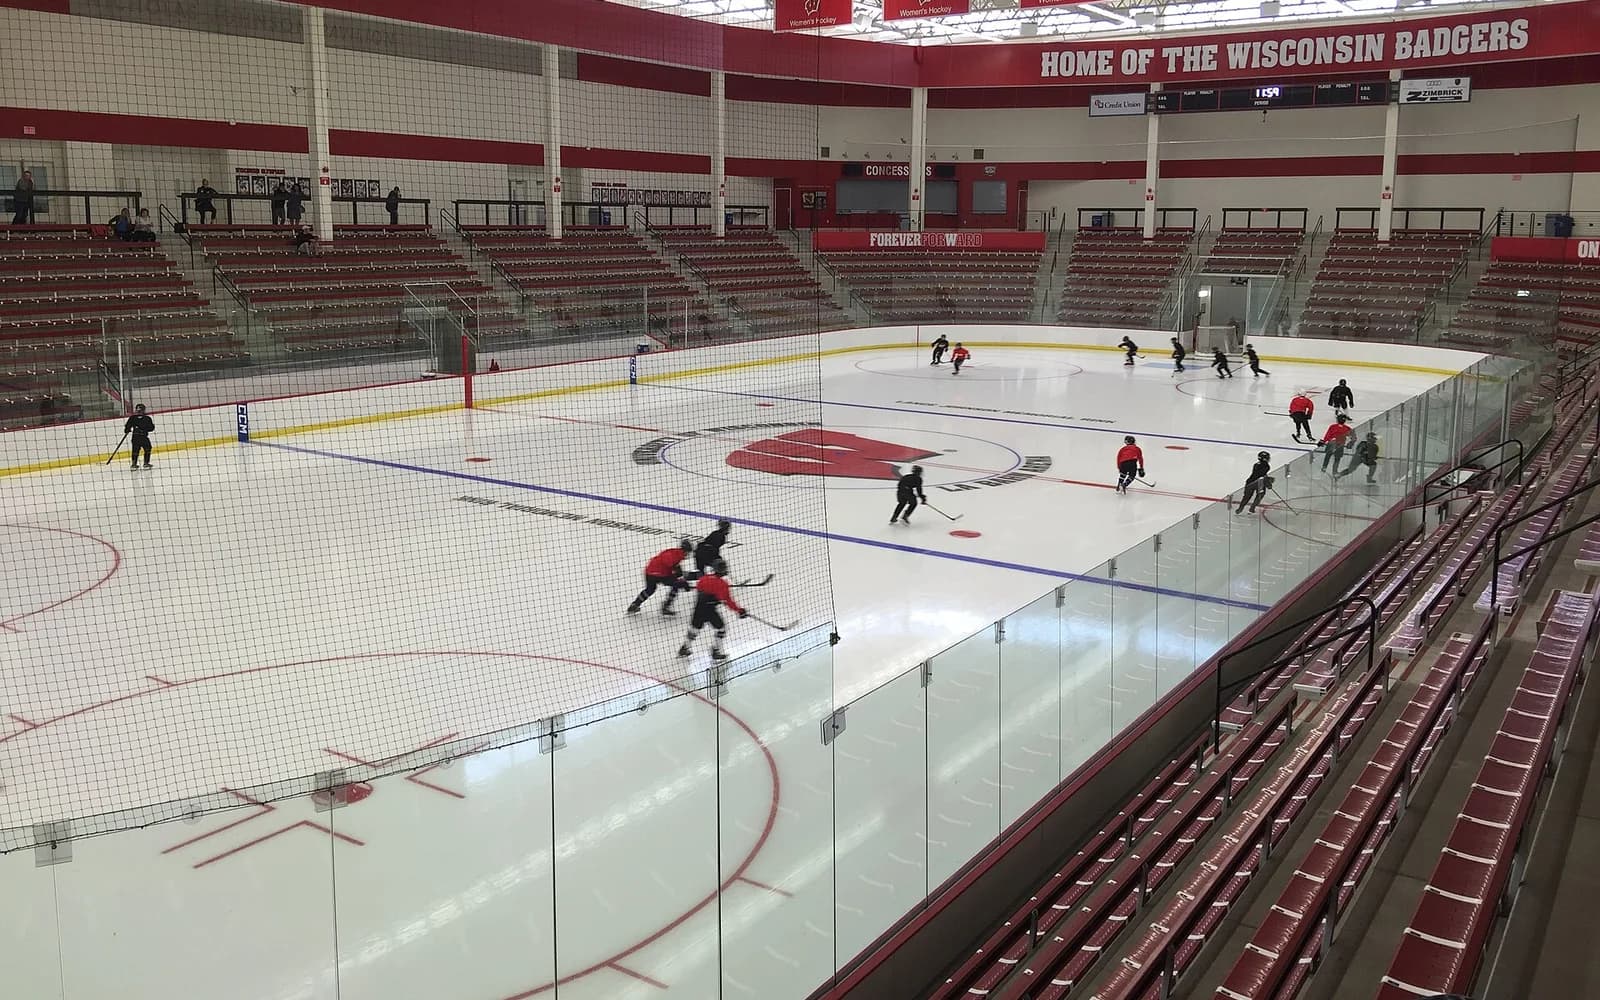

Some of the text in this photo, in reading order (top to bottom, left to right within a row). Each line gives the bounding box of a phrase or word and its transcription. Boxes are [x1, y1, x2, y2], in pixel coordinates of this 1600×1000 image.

[899, 6, 952, 17] Women's Hockey
[789, 17, 837, 27] Women's Hockey
[1041, 18, 1529, 77] HOME OF THE WISCONSIN BADGERS
[1422, 89, 1463, 97] ZIMBRICK
[866, 165, 932, 176] CONCESSS
